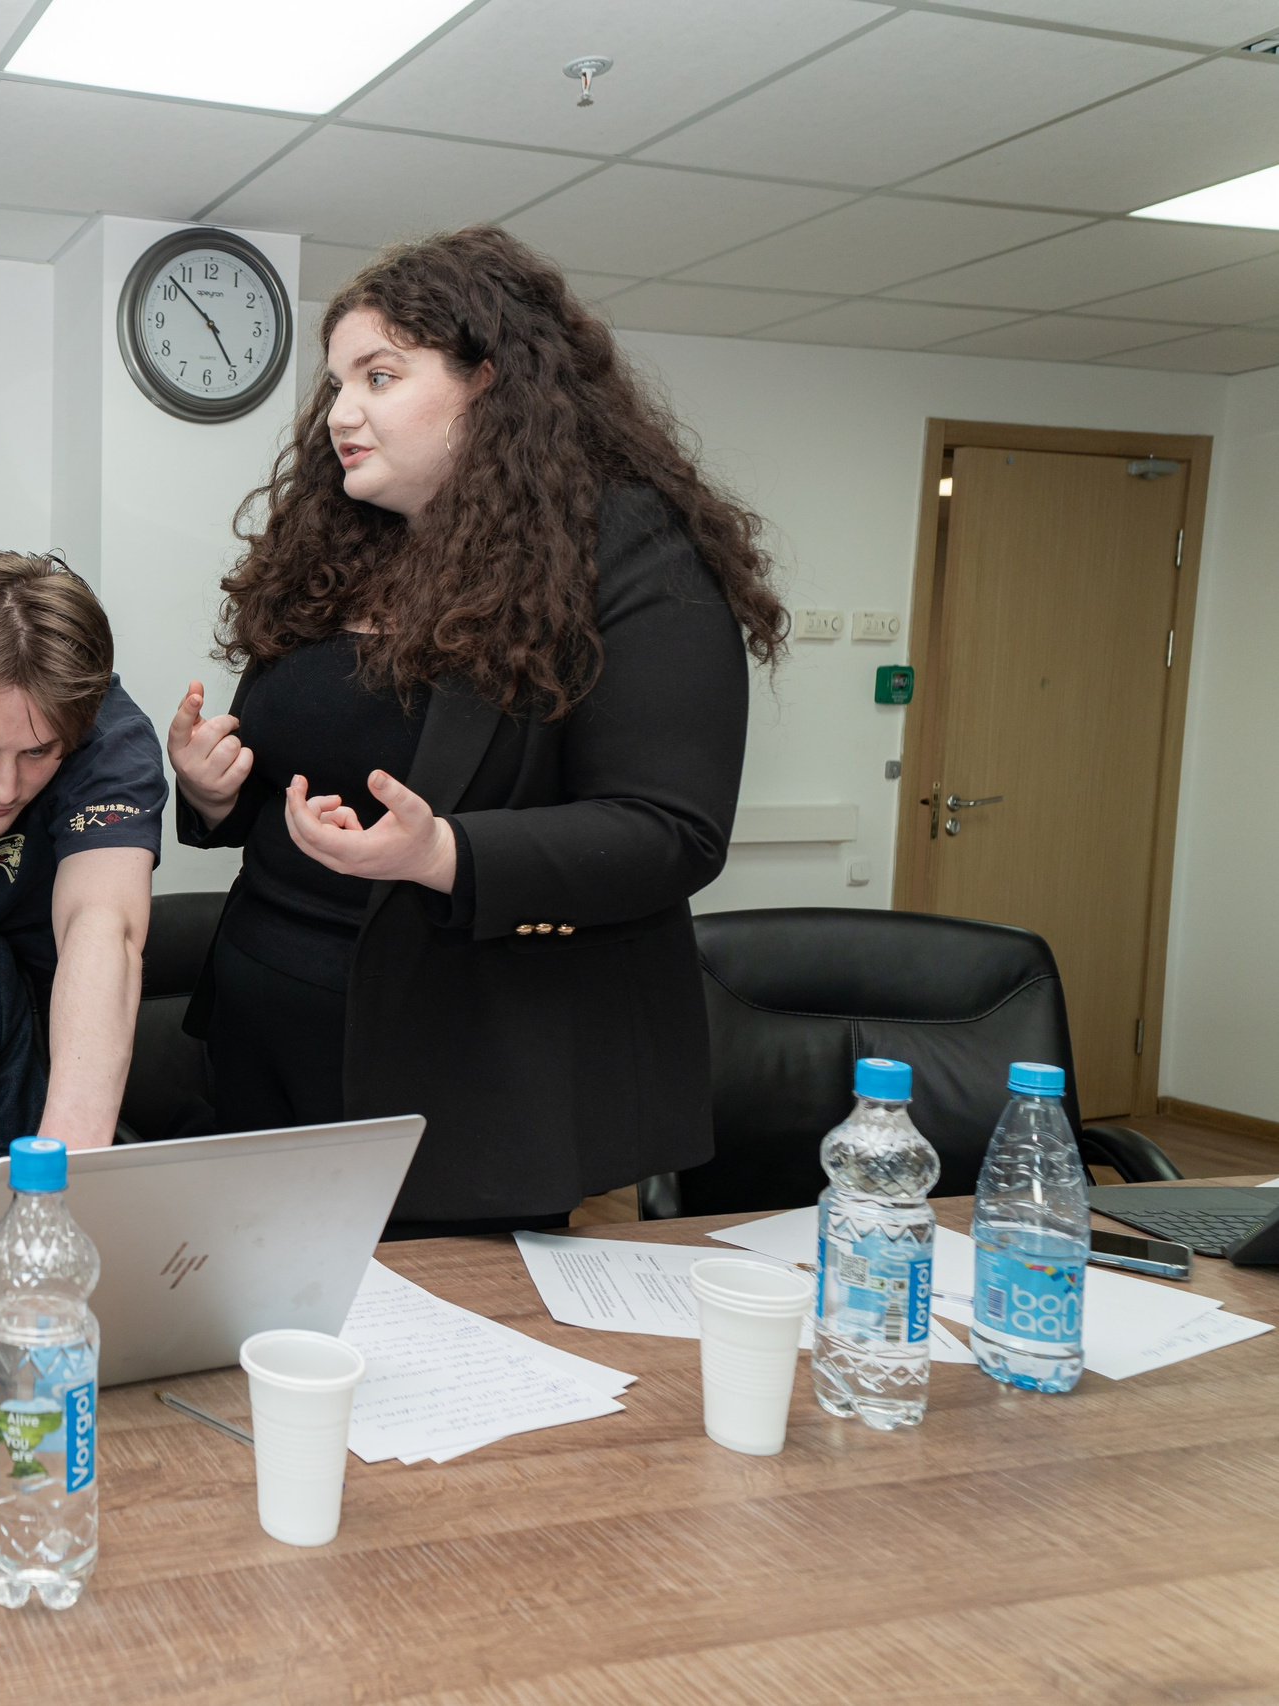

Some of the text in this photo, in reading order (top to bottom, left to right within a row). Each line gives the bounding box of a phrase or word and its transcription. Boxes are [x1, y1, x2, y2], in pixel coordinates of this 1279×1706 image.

[182, 266, 193, 283] 11
[205, 263, 219, 280] 12
[234, 271, 239, 288] 1
[163, 284, 178, 301] 10
[246, 292, 256, 309] 2
[155, 312, 165, 329] 9
[252, 321, 262, 338] 3
[161, 340, 171, 356] 8
[244, 347, 253, 363] 4
[179, 361, 187, 377] 7
[202, 369, 212, 386] 6
[227, 364, 237, 381] 5
[911, 1262, 930, 1340] Vorgol
[1012, 1283, 1079, 1314] bon
[1012, 1310, 1082, 1340] aqu
[7, 1413, 39, 1427] Alive
[72, 1386, 92, 1489] Vorgol
